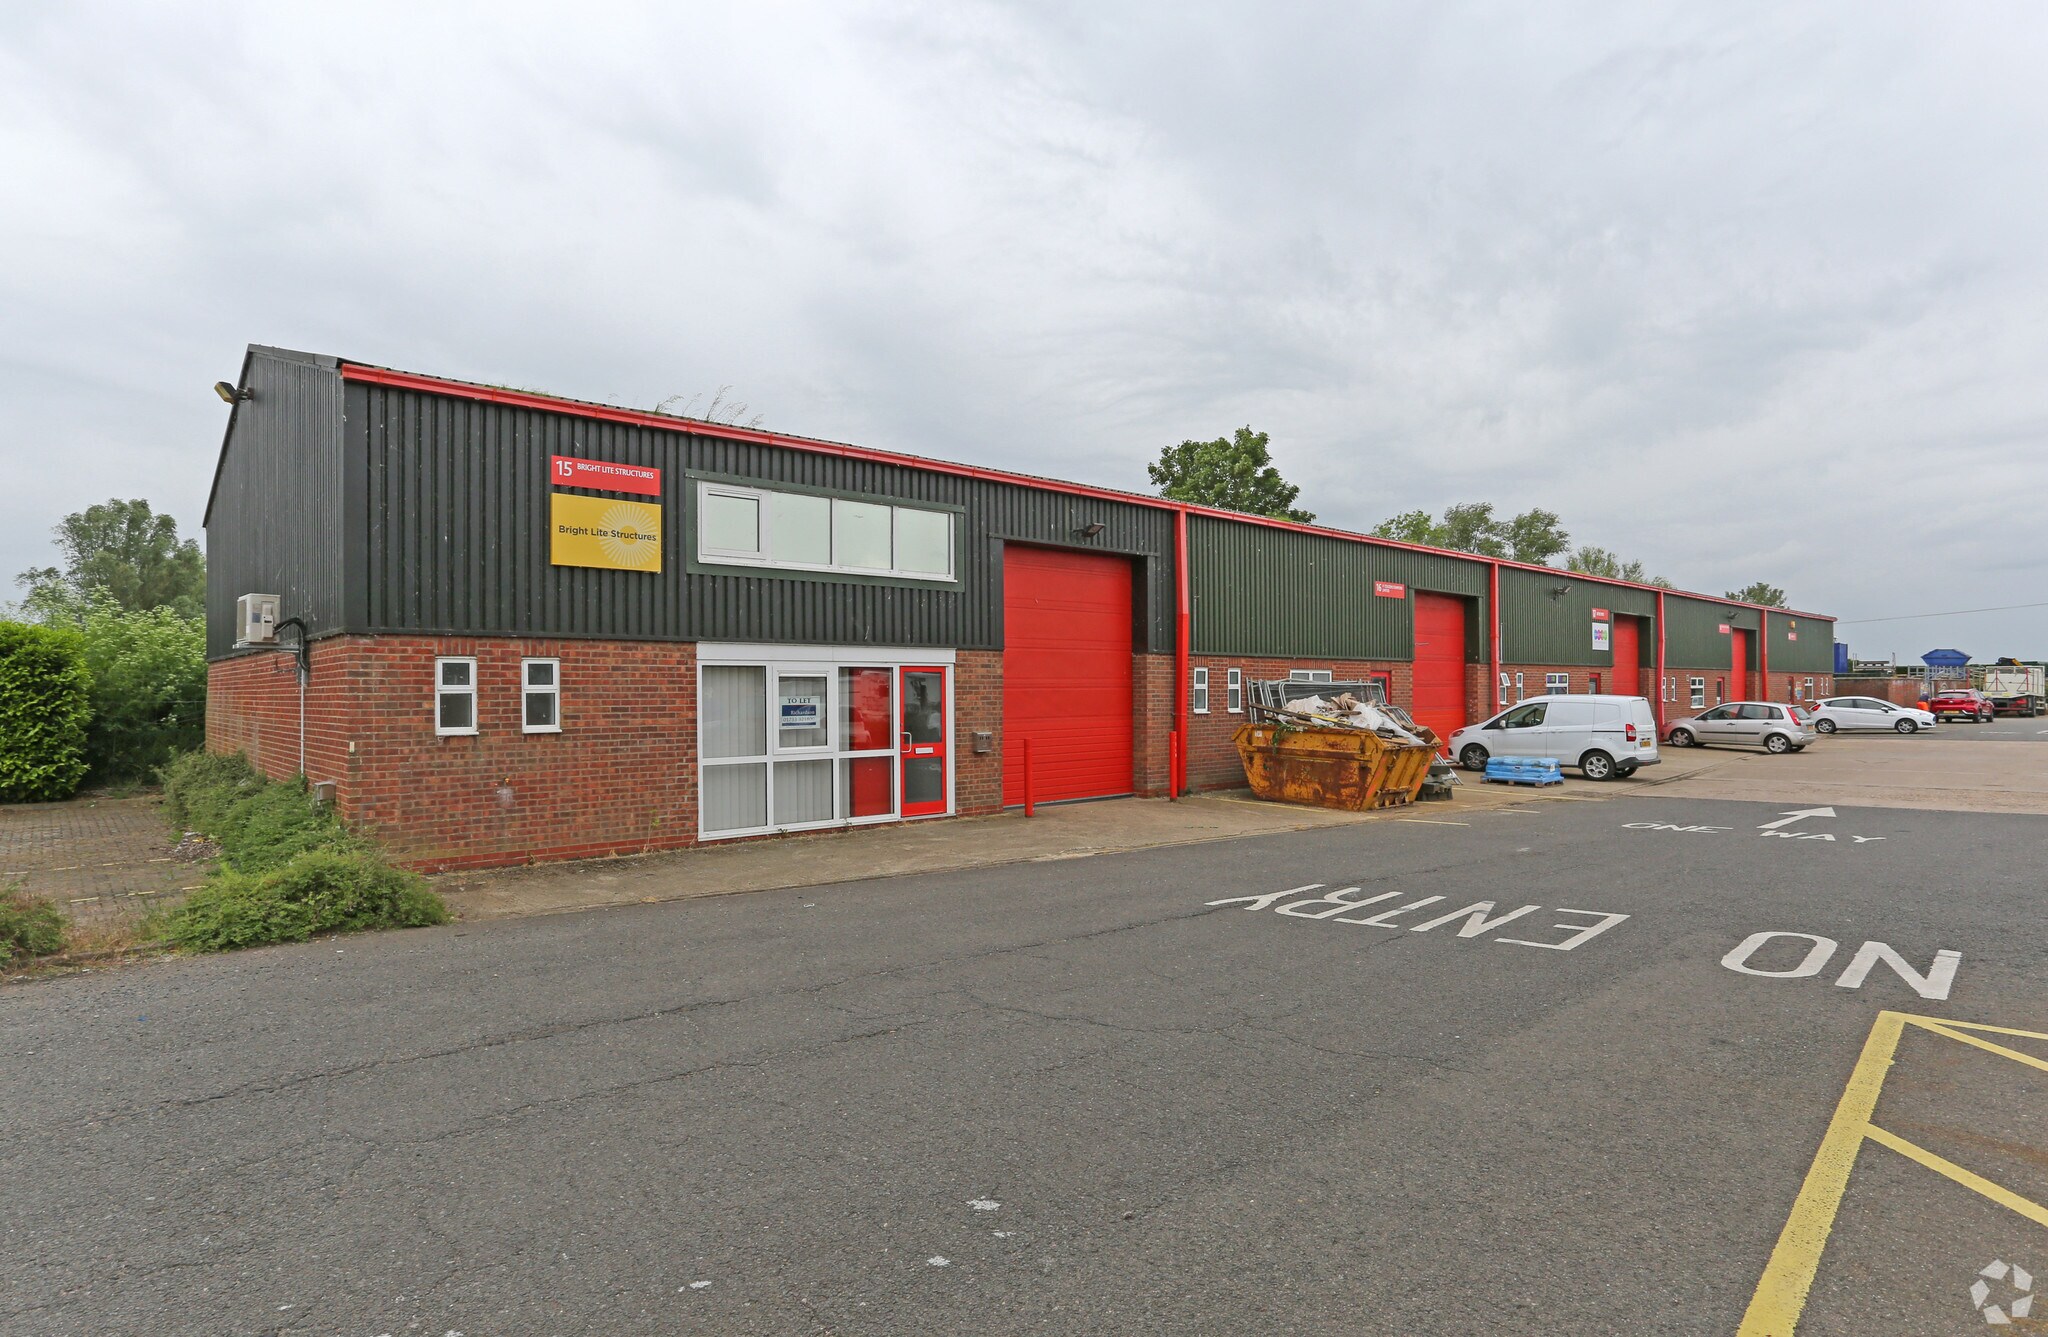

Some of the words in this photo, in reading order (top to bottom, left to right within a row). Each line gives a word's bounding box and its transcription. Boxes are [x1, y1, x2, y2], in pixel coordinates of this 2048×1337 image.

[556, 460, 573, 477] 15
[577, 463, 601, 473] BRIGHT
[602, 466, 614, 474] LITE
[615, 468, 654, 479] STRUCTURES
[559, 525, 588, 536] Bright
[591, 528, 608, 537] Lite
[611, 530, 657, 541] Structures
[1621, 821, 1734, 834] ONE
[1760, 830, 1887, 843] WAY
[1204, 884, 1632, 951] ENTRY
[1721, 931, 1962, 1000] NO
